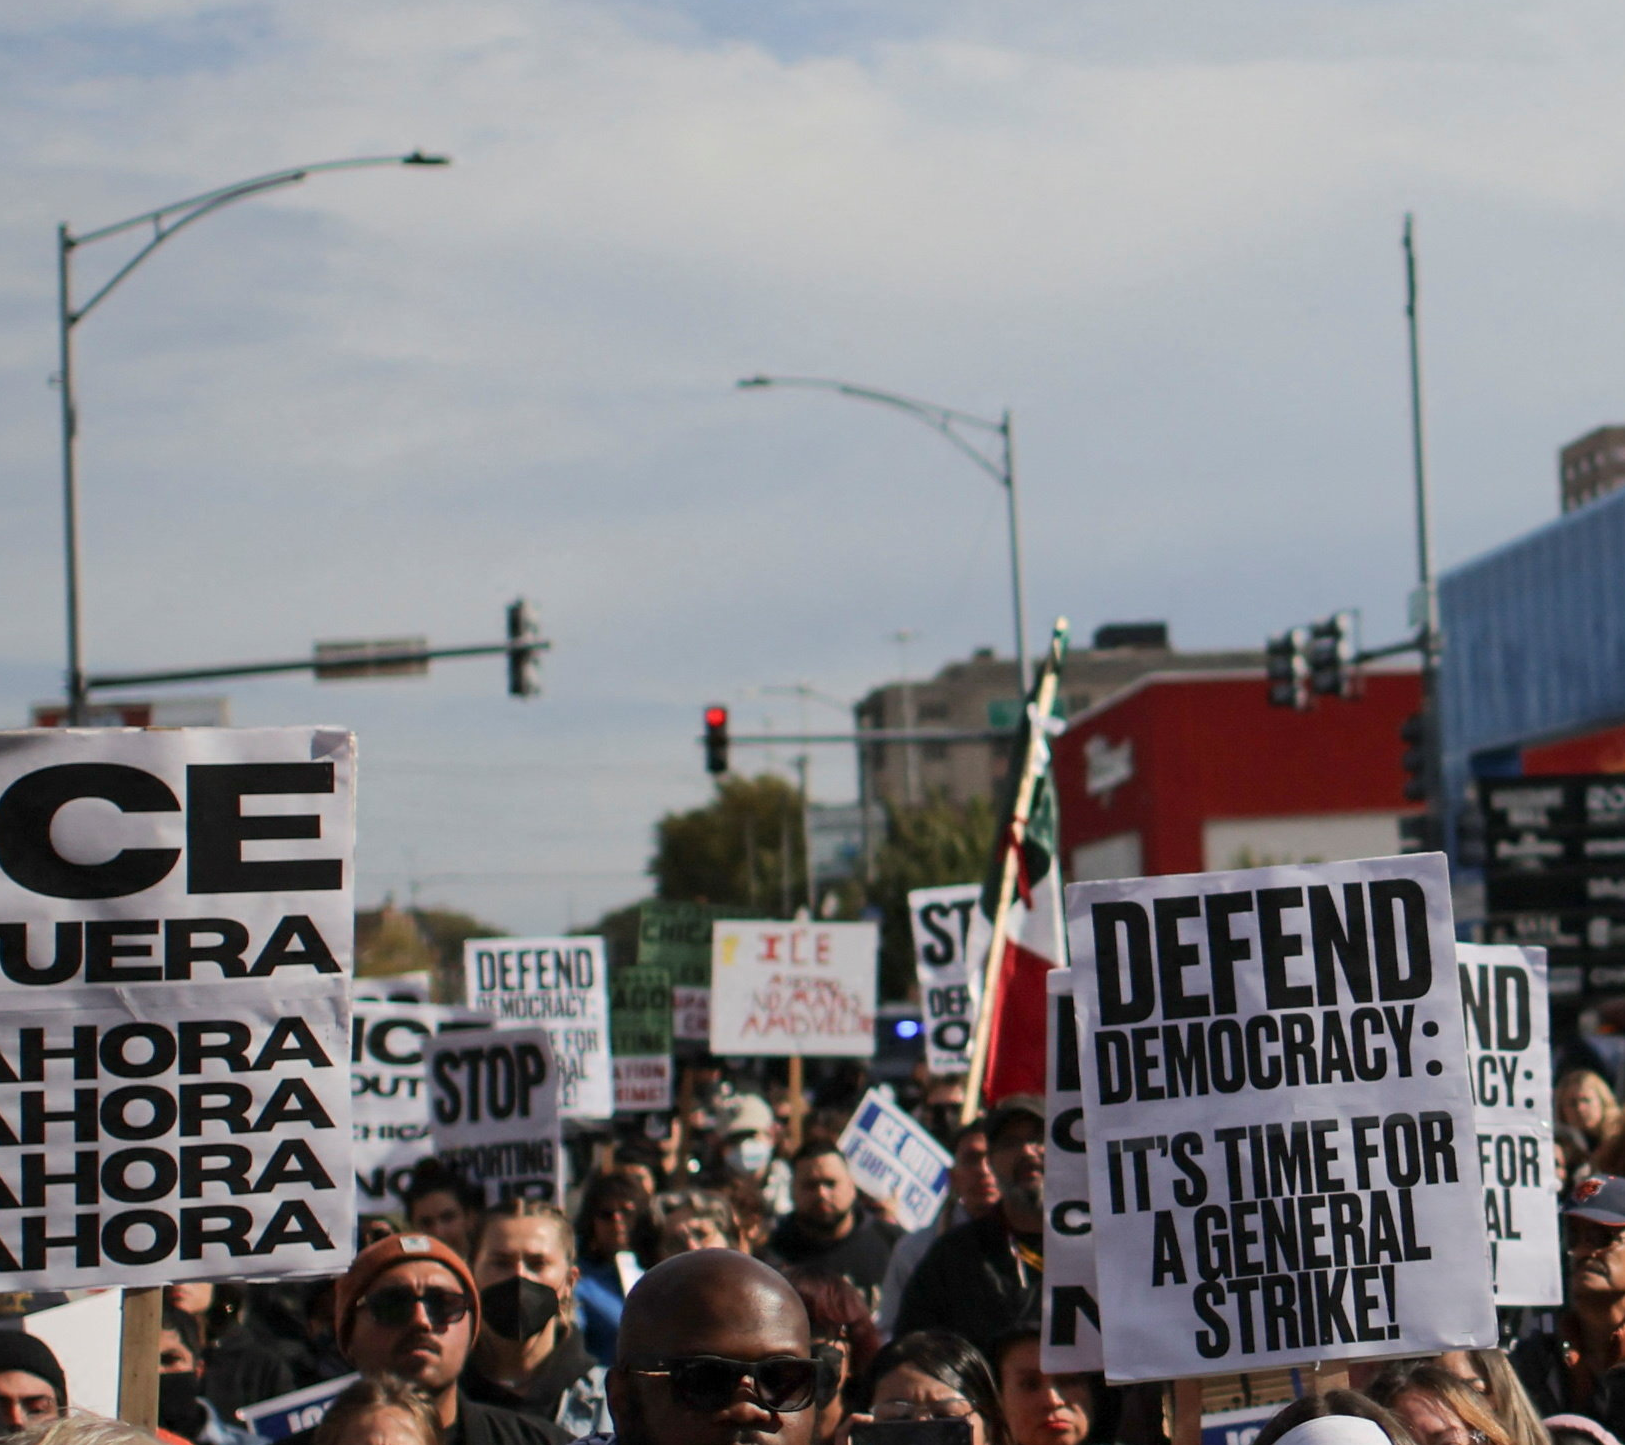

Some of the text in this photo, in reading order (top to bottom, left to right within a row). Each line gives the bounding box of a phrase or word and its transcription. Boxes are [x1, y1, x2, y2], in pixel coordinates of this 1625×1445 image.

[476, 947, 595, 993] DEFEND
[755, 931, 831, 965] ICE
[1090, 877, 1434, 1028] DEFEND
[352, 1016, 493, 1067] IC
[565, 1031, 598, 1053] FOR
[1093, 1004, 1445, 1106] DEMOCRACY:
[431, 1042, 548, 1126] STOP
[1474, 1056, 1536, 1110] CY:
[439, 1138, 554, 1179] PORTING
[1106, 1110, 1459, 1215] IT'S TIME FOR
[1151, 1210, 1188, 1288] A
[1193, 1187, 1432, 1283] GENERAL
[1193, 1263, 1401, 1360] STRIKE!
